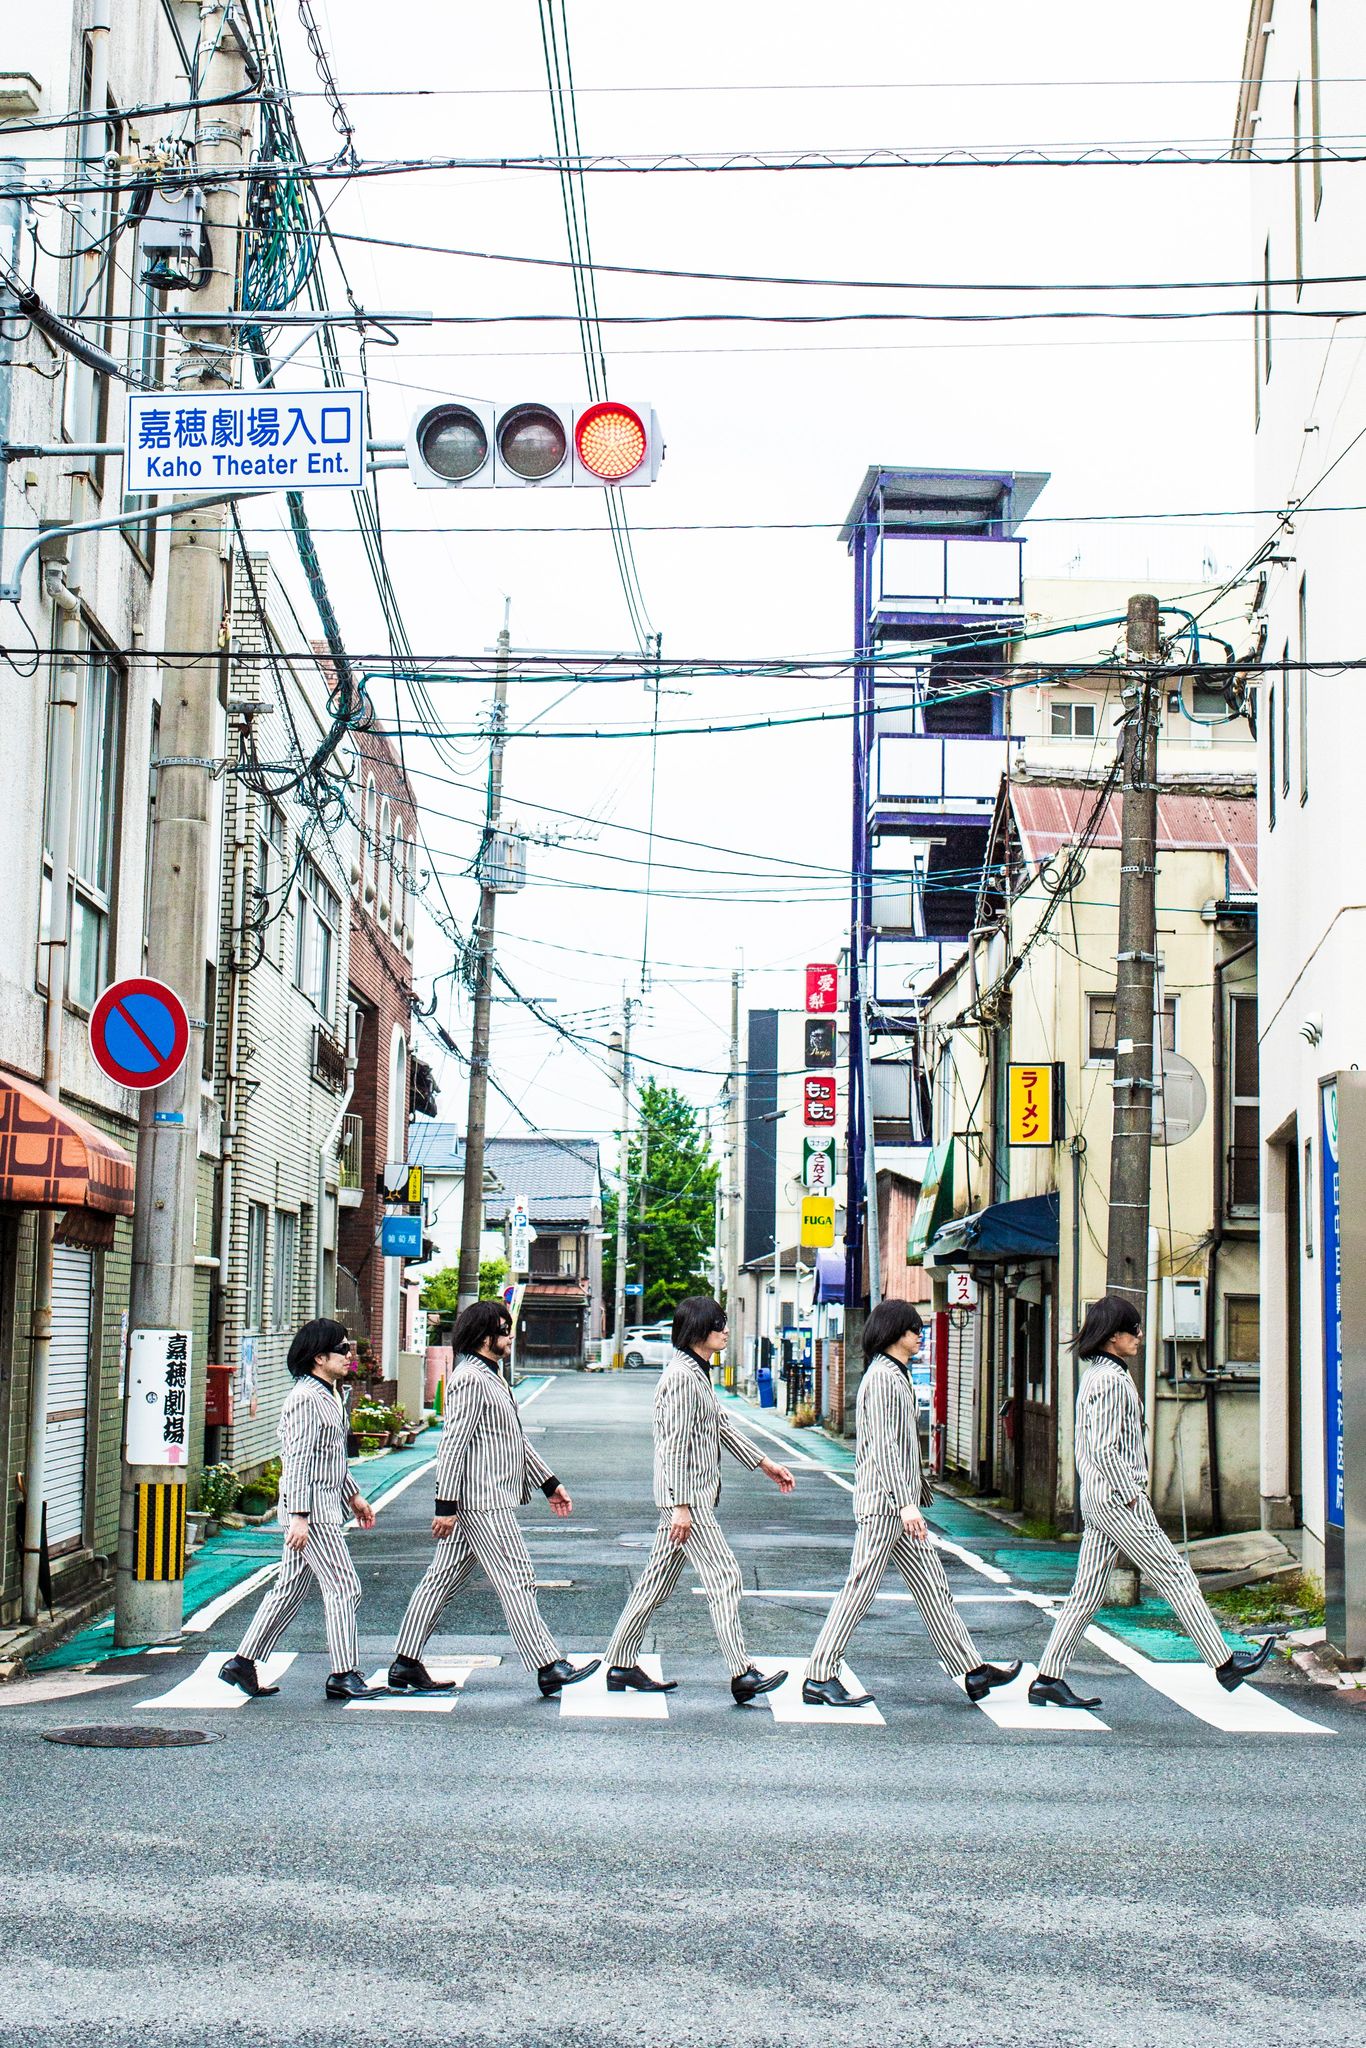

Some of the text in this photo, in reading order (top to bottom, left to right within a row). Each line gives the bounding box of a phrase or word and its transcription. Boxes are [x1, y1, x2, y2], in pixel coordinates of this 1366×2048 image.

[138, 407, 351, 449] 嘉穂劇場入口
[147, 452, 349, 477] Kaho Theater Ent.
[805, 1081, 830, 1099] もこ
[807, 1101, 834, 1120] もこ
[1021, 1071, 1039, 1139] ラーメン
[813, 1153, 825, 1184] さなえ
[804, 1215, 833, 1225] FUGA
[163, 1333, 188, 1445] 嘉穂劇場
